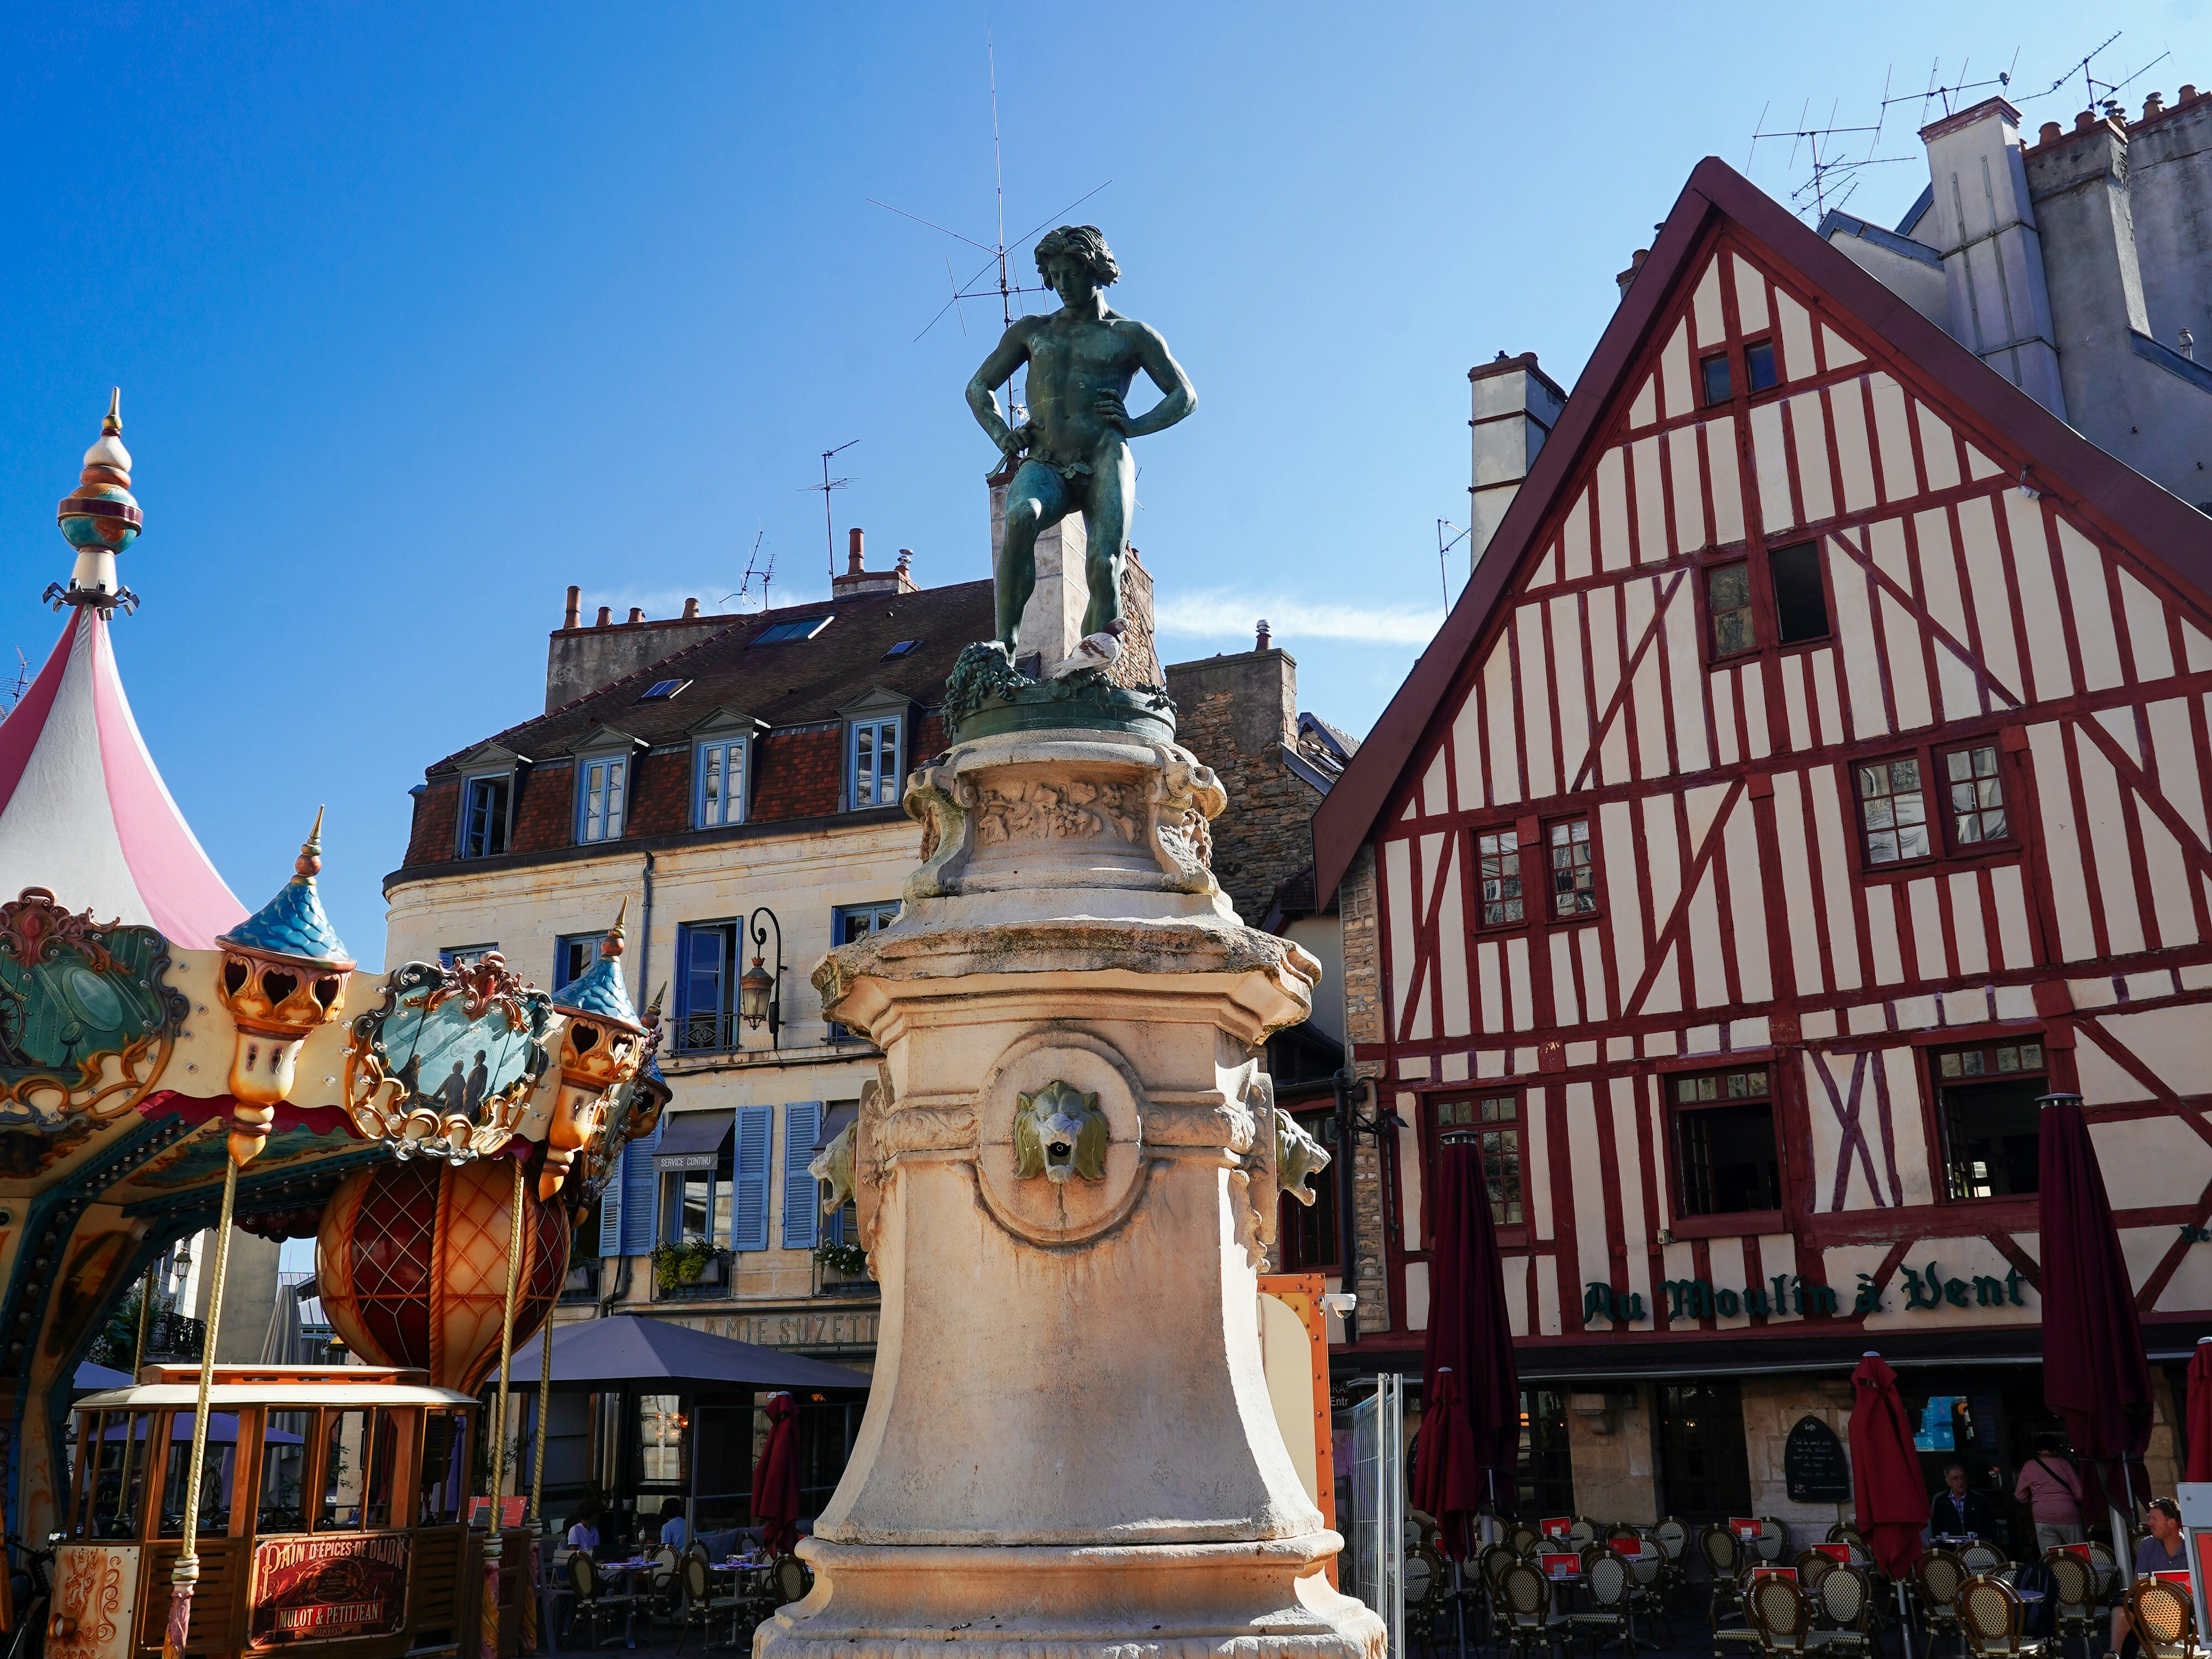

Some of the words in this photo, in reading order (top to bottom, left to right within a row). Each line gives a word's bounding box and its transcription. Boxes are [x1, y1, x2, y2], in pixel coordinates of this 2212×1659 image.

[660, 1157, 685, 1167] SERVICE
[686, 1156, 711, 1166] CONTINU
[1582, 1281, 1646, 1324] Au
[1657, 1274, 1838, 1322] Moulin
[1899, 1260, 2025, 1311] Vent
[708, 1318, 768, 1345] AMIE
[258, 1543, 305, 1608] PAIN
[354, 1541, 367, 1557] DE
[369, 1537, 405, 1570] DIJON
[279, 1608, 314, 1629] MULOT
[315, 1608, 324, 1625] &
